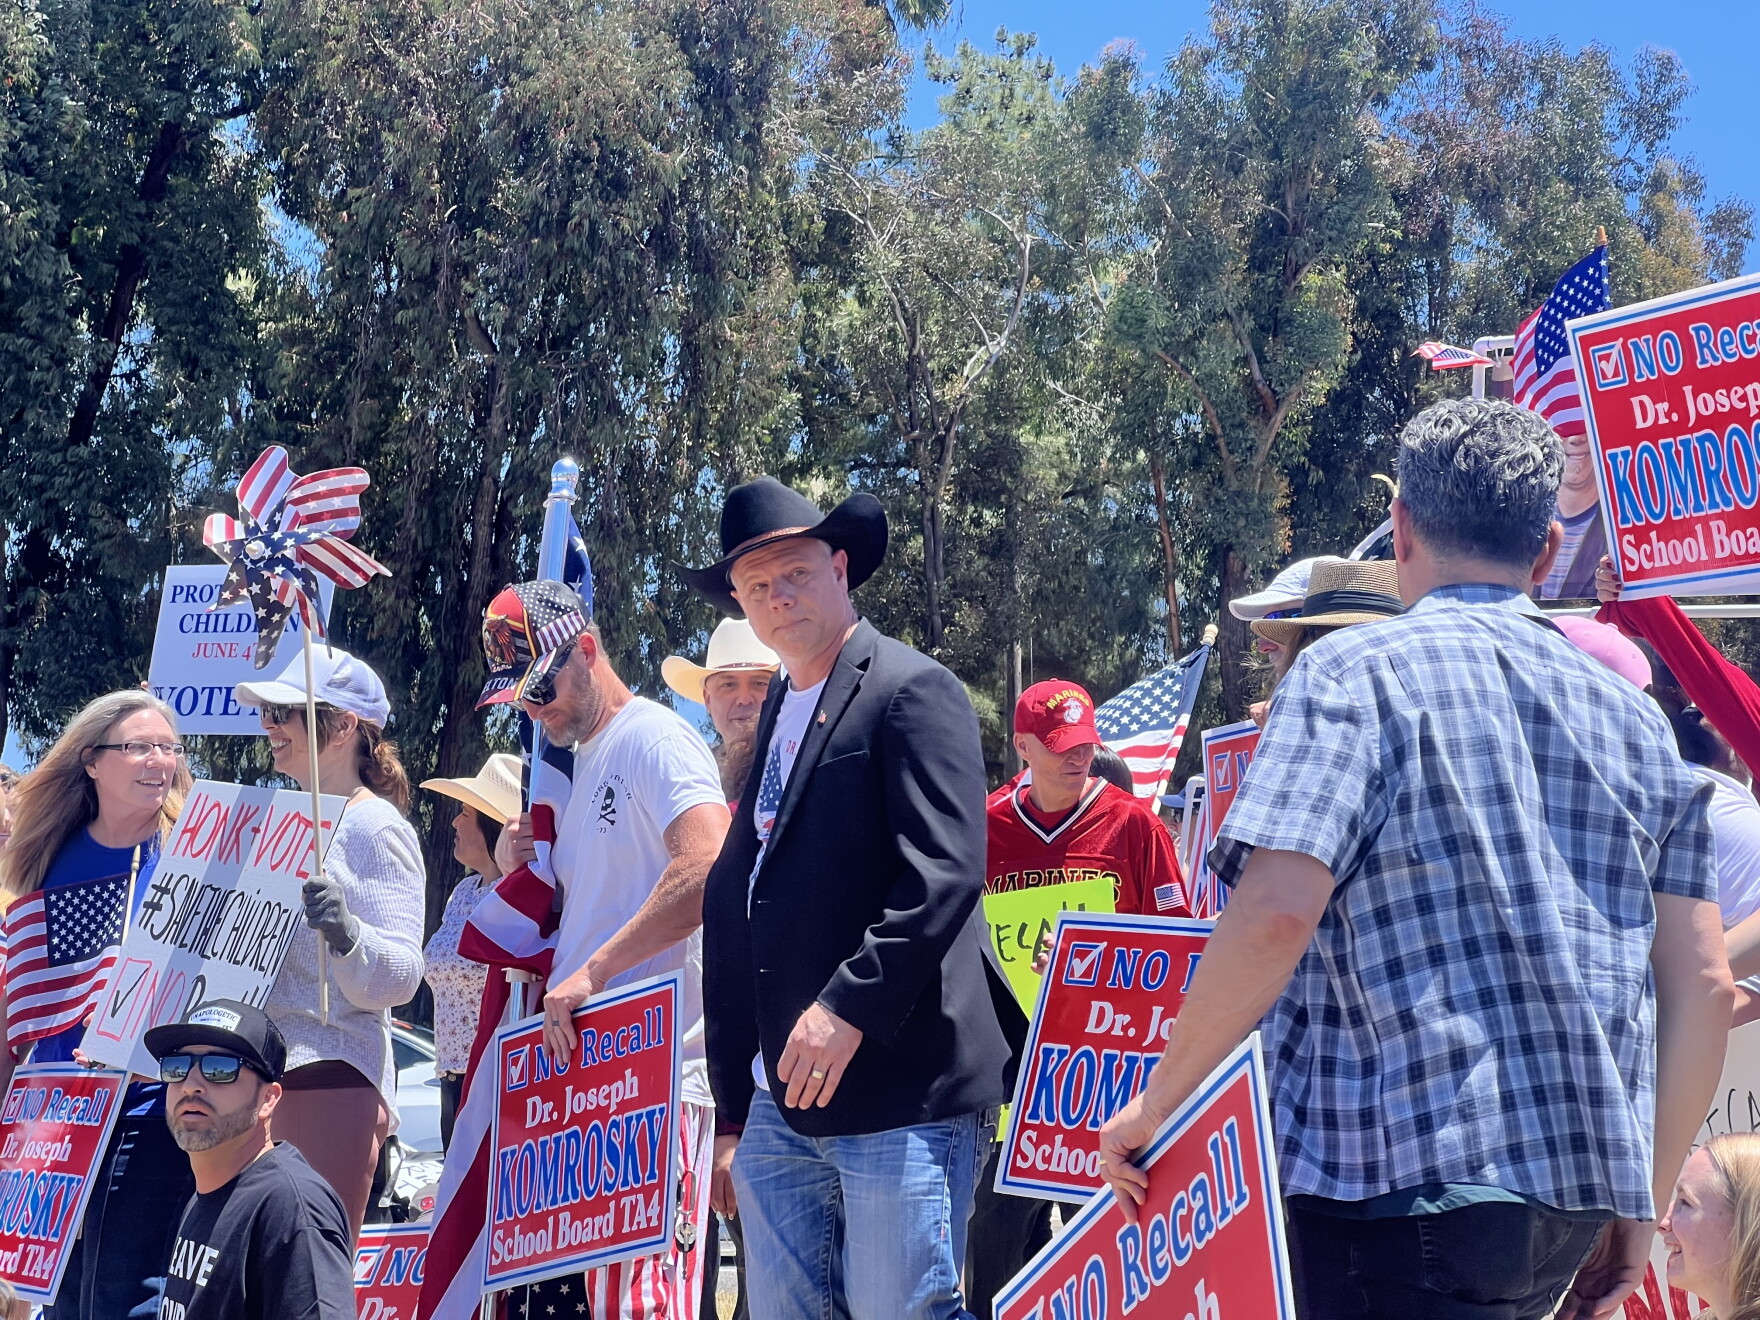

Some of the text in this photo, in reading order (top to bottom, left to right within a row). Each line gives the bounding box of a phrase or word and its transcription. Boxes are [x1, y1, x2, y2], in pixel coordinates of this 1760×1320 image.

[1628, 330, 1683, 382] NO
[1630, 394, 1679, 429] Dr.
[1622, 524, 1708, 572] School
[178, 612, 300, 633] CHILDN
[192, 642, 239, 659] JUNE
[1046, 689, 1090, 710] MARINES
[171, 792, 260, 865] HONK
[1106, 947, 1171, 992] NO
[581, 1004, 664, 1069] Recall
[1084, 1001, 1136, 1038] Dr.
[16, 1087, 110, 1126] NO Recall
[525, 1068, 640, 1129] Dr. Joseph
[16, 1134, 73, 1168] Joseph
[494, 1102, 668, 1225] KOMROSKY
[491, 1189, 661, 1266] School Board TA4
[1116, 1115, 1250, 1316] Recall
[21, 1243, 57, 1280] TA4
[358, 1297, 400, 1320] Dr
